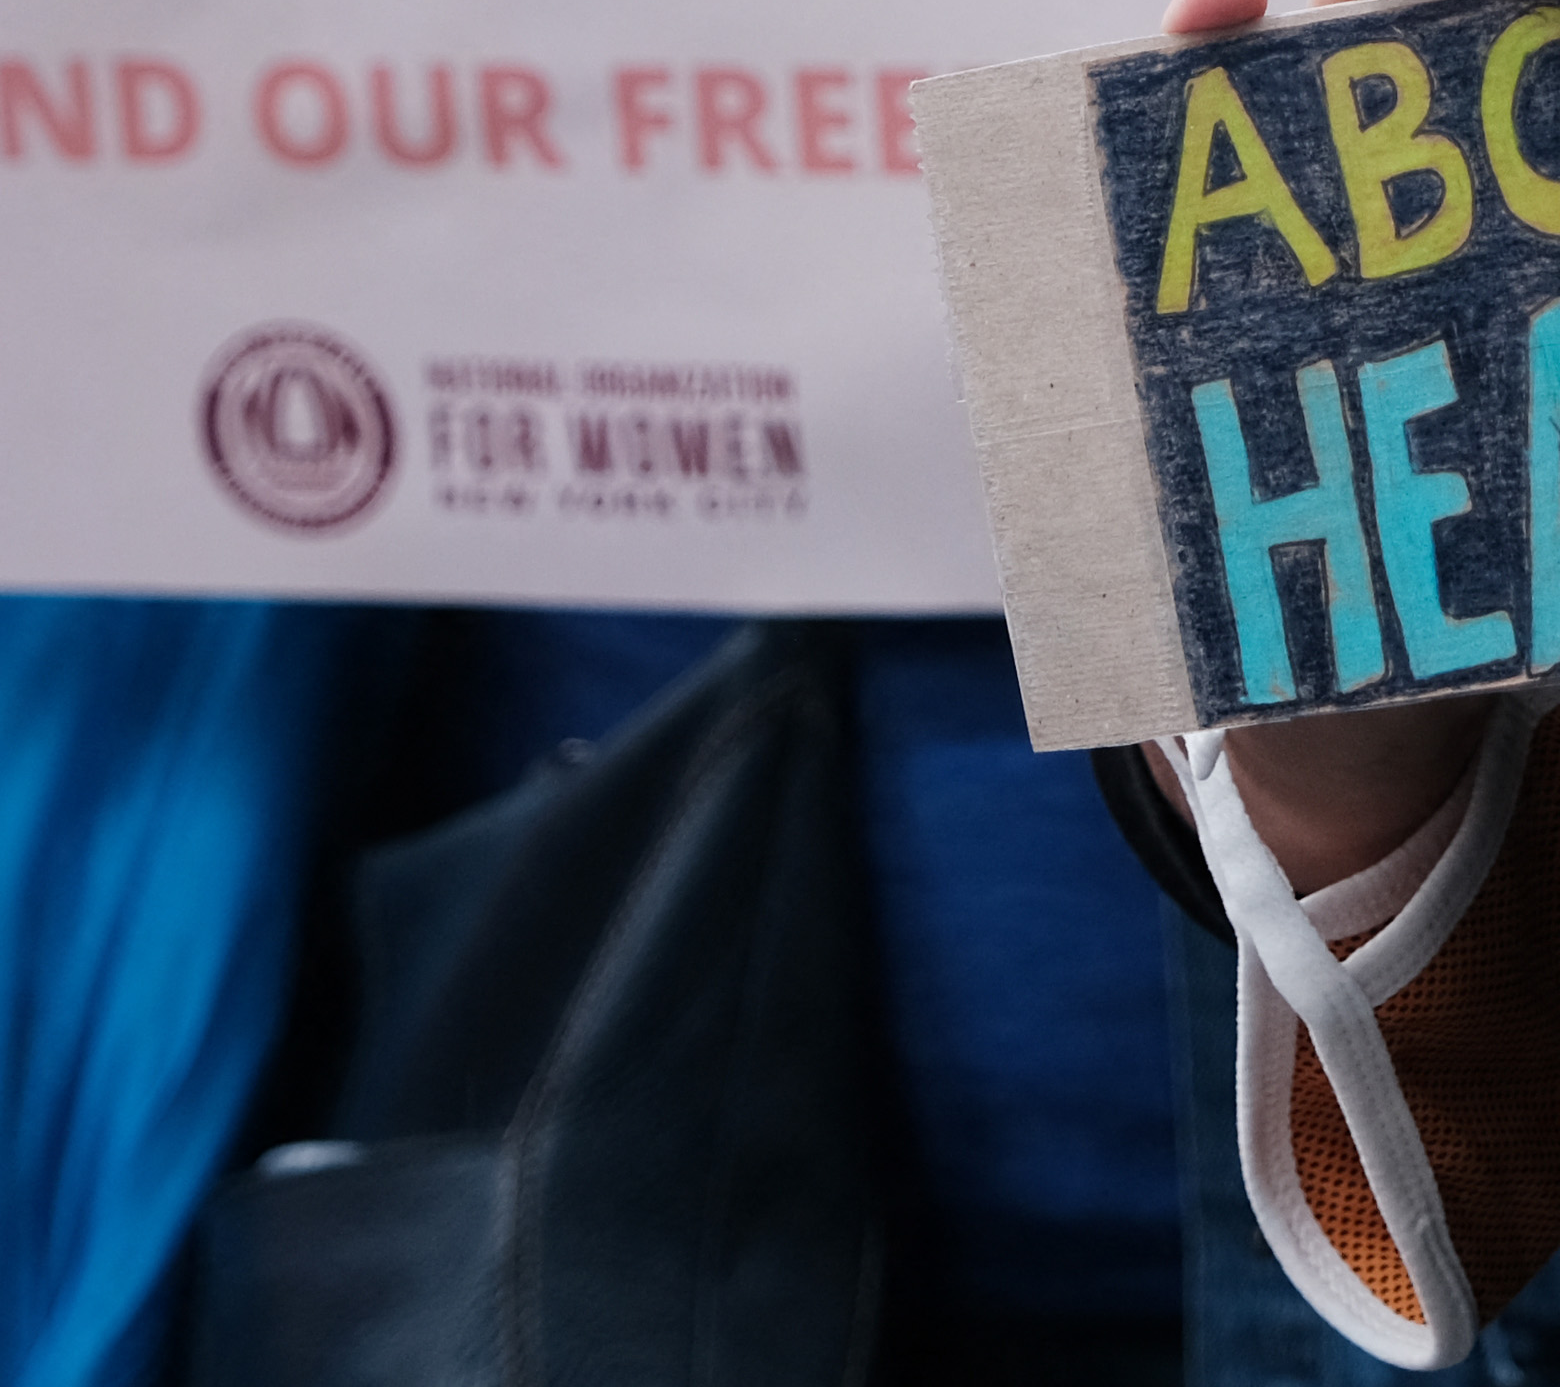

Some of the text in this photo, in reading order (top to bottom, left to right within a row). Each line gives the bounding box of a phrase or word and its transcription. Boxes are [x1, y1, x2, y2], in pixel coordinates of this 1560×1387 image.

[253, 62, 564, 170] OUR
[432, 407, 804, 481] FOR WOMEN
